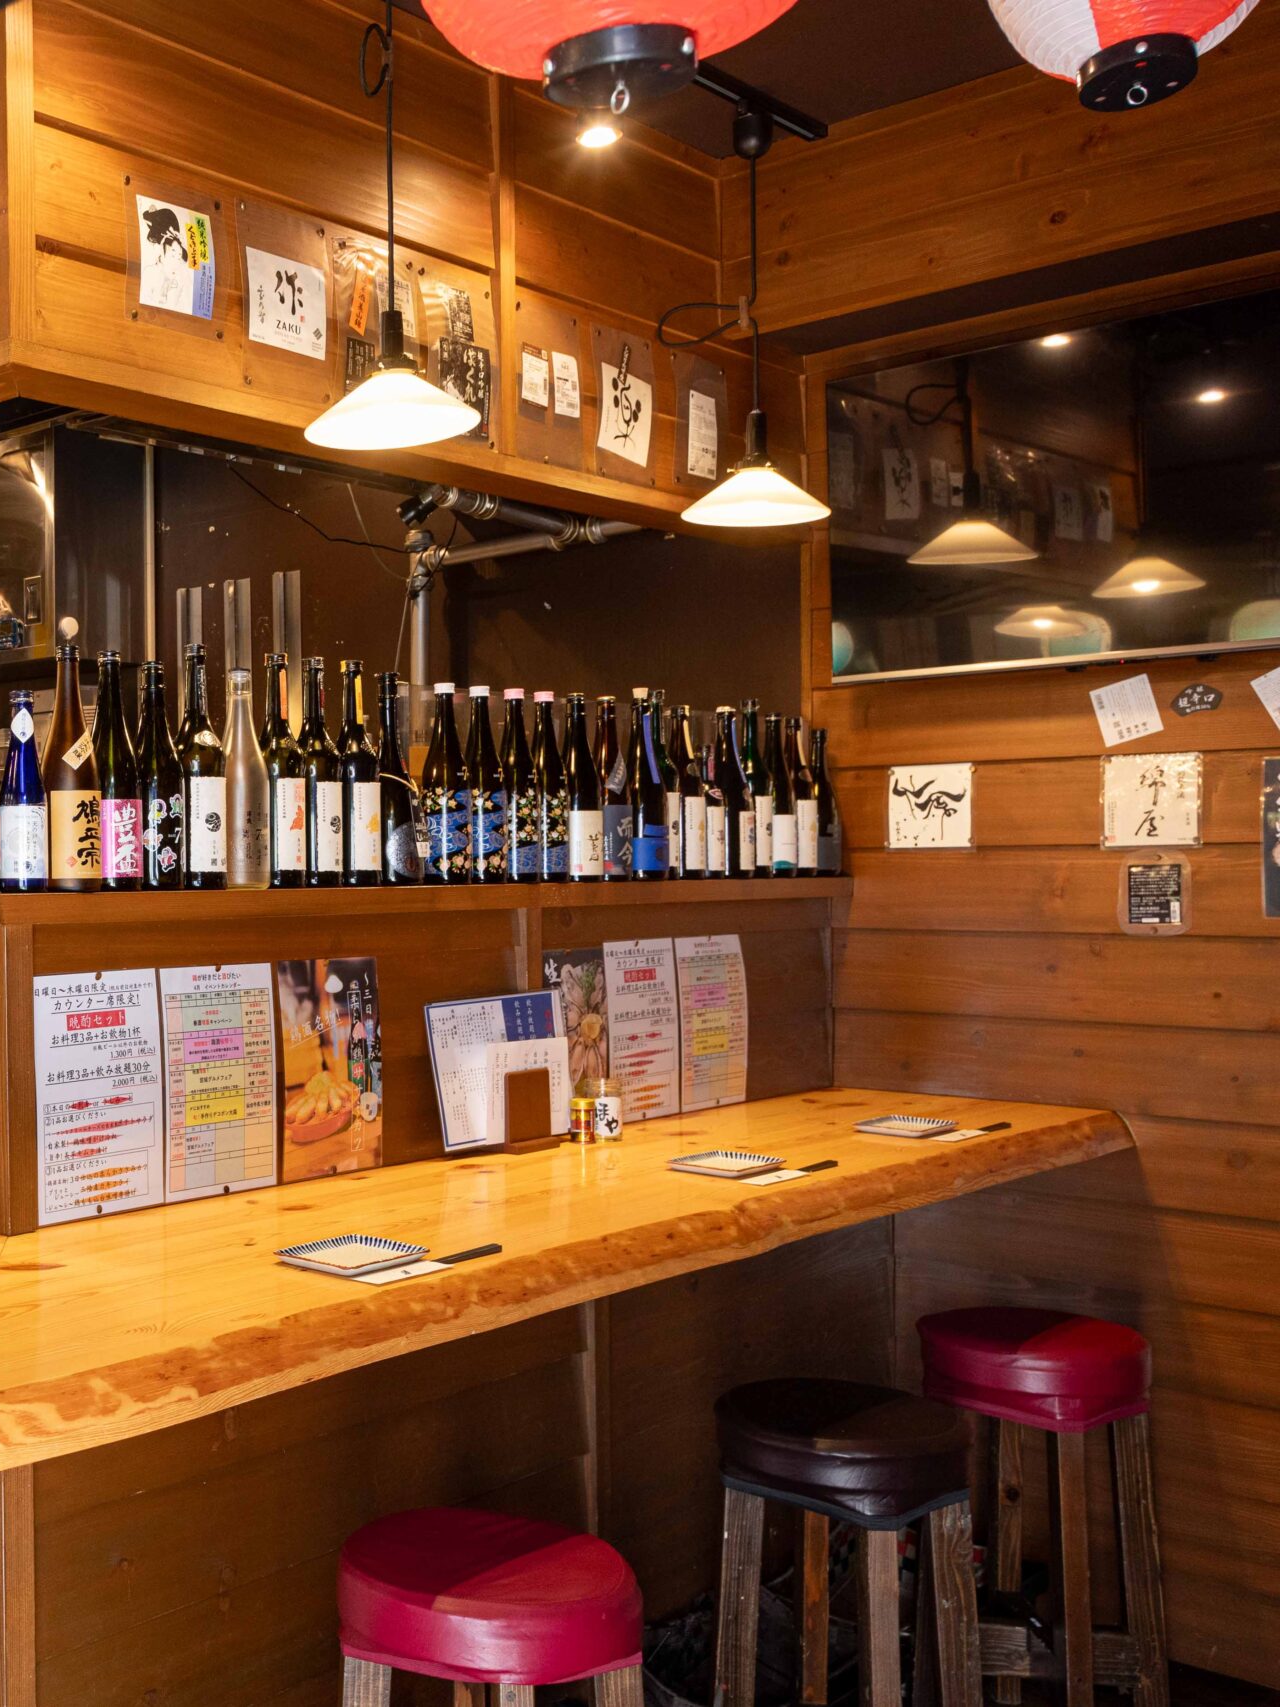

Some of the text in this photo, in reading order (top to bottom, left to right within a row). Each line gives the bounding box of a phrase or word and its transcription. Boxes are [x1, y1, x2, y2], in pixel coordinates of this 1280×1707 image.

[275, 269, 304, 316] 作
[276, 319, 302, 336] ZAKU
[72, 795, 102, 868] 鳩正宗
[114, 805, 140, 875] 豊盃
[543, 958, 562, 983] 生
[54, 993, 140, 1011] カウンター席限定!
[68, 1011, 125, 1029] 晩酌セット
[51, 1027, 141, 1045] お料理3品+お飲物1杯
[47, 1061, 151, 1083] お料理3品+飲み放題30分
[594, 1102, 620, 1134] ほや
